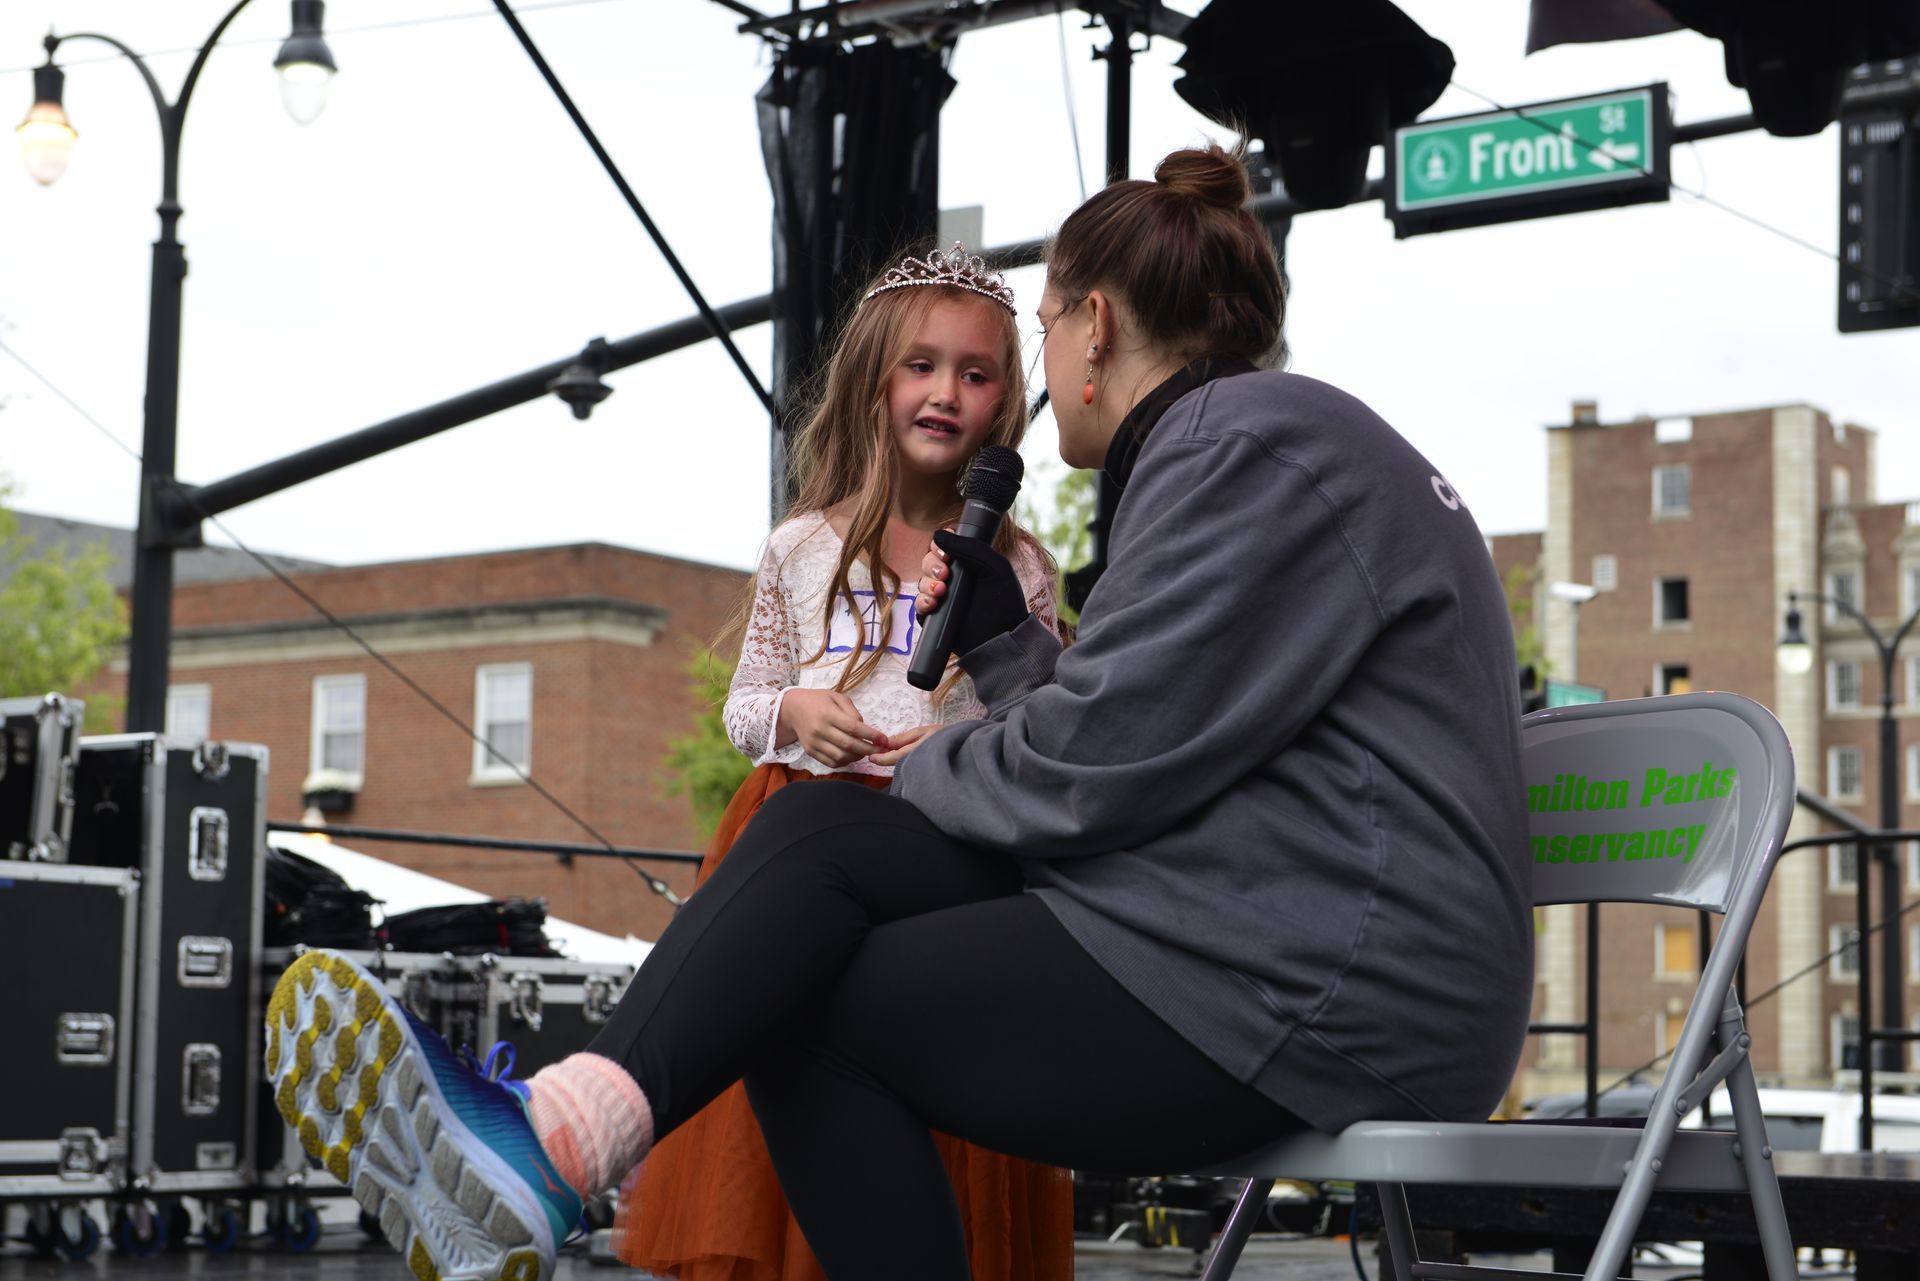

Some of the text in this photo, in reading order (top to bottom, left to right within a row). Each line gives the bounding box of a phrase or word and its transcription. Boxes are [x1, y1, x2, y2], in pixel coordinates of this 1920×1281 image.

[1599, 104, 1627, 134] St
[1469, 120, 1578, 184] Front
[1640, 761, 1738, 807] Parks
[1530, 824, 1706, 865] nservancy
